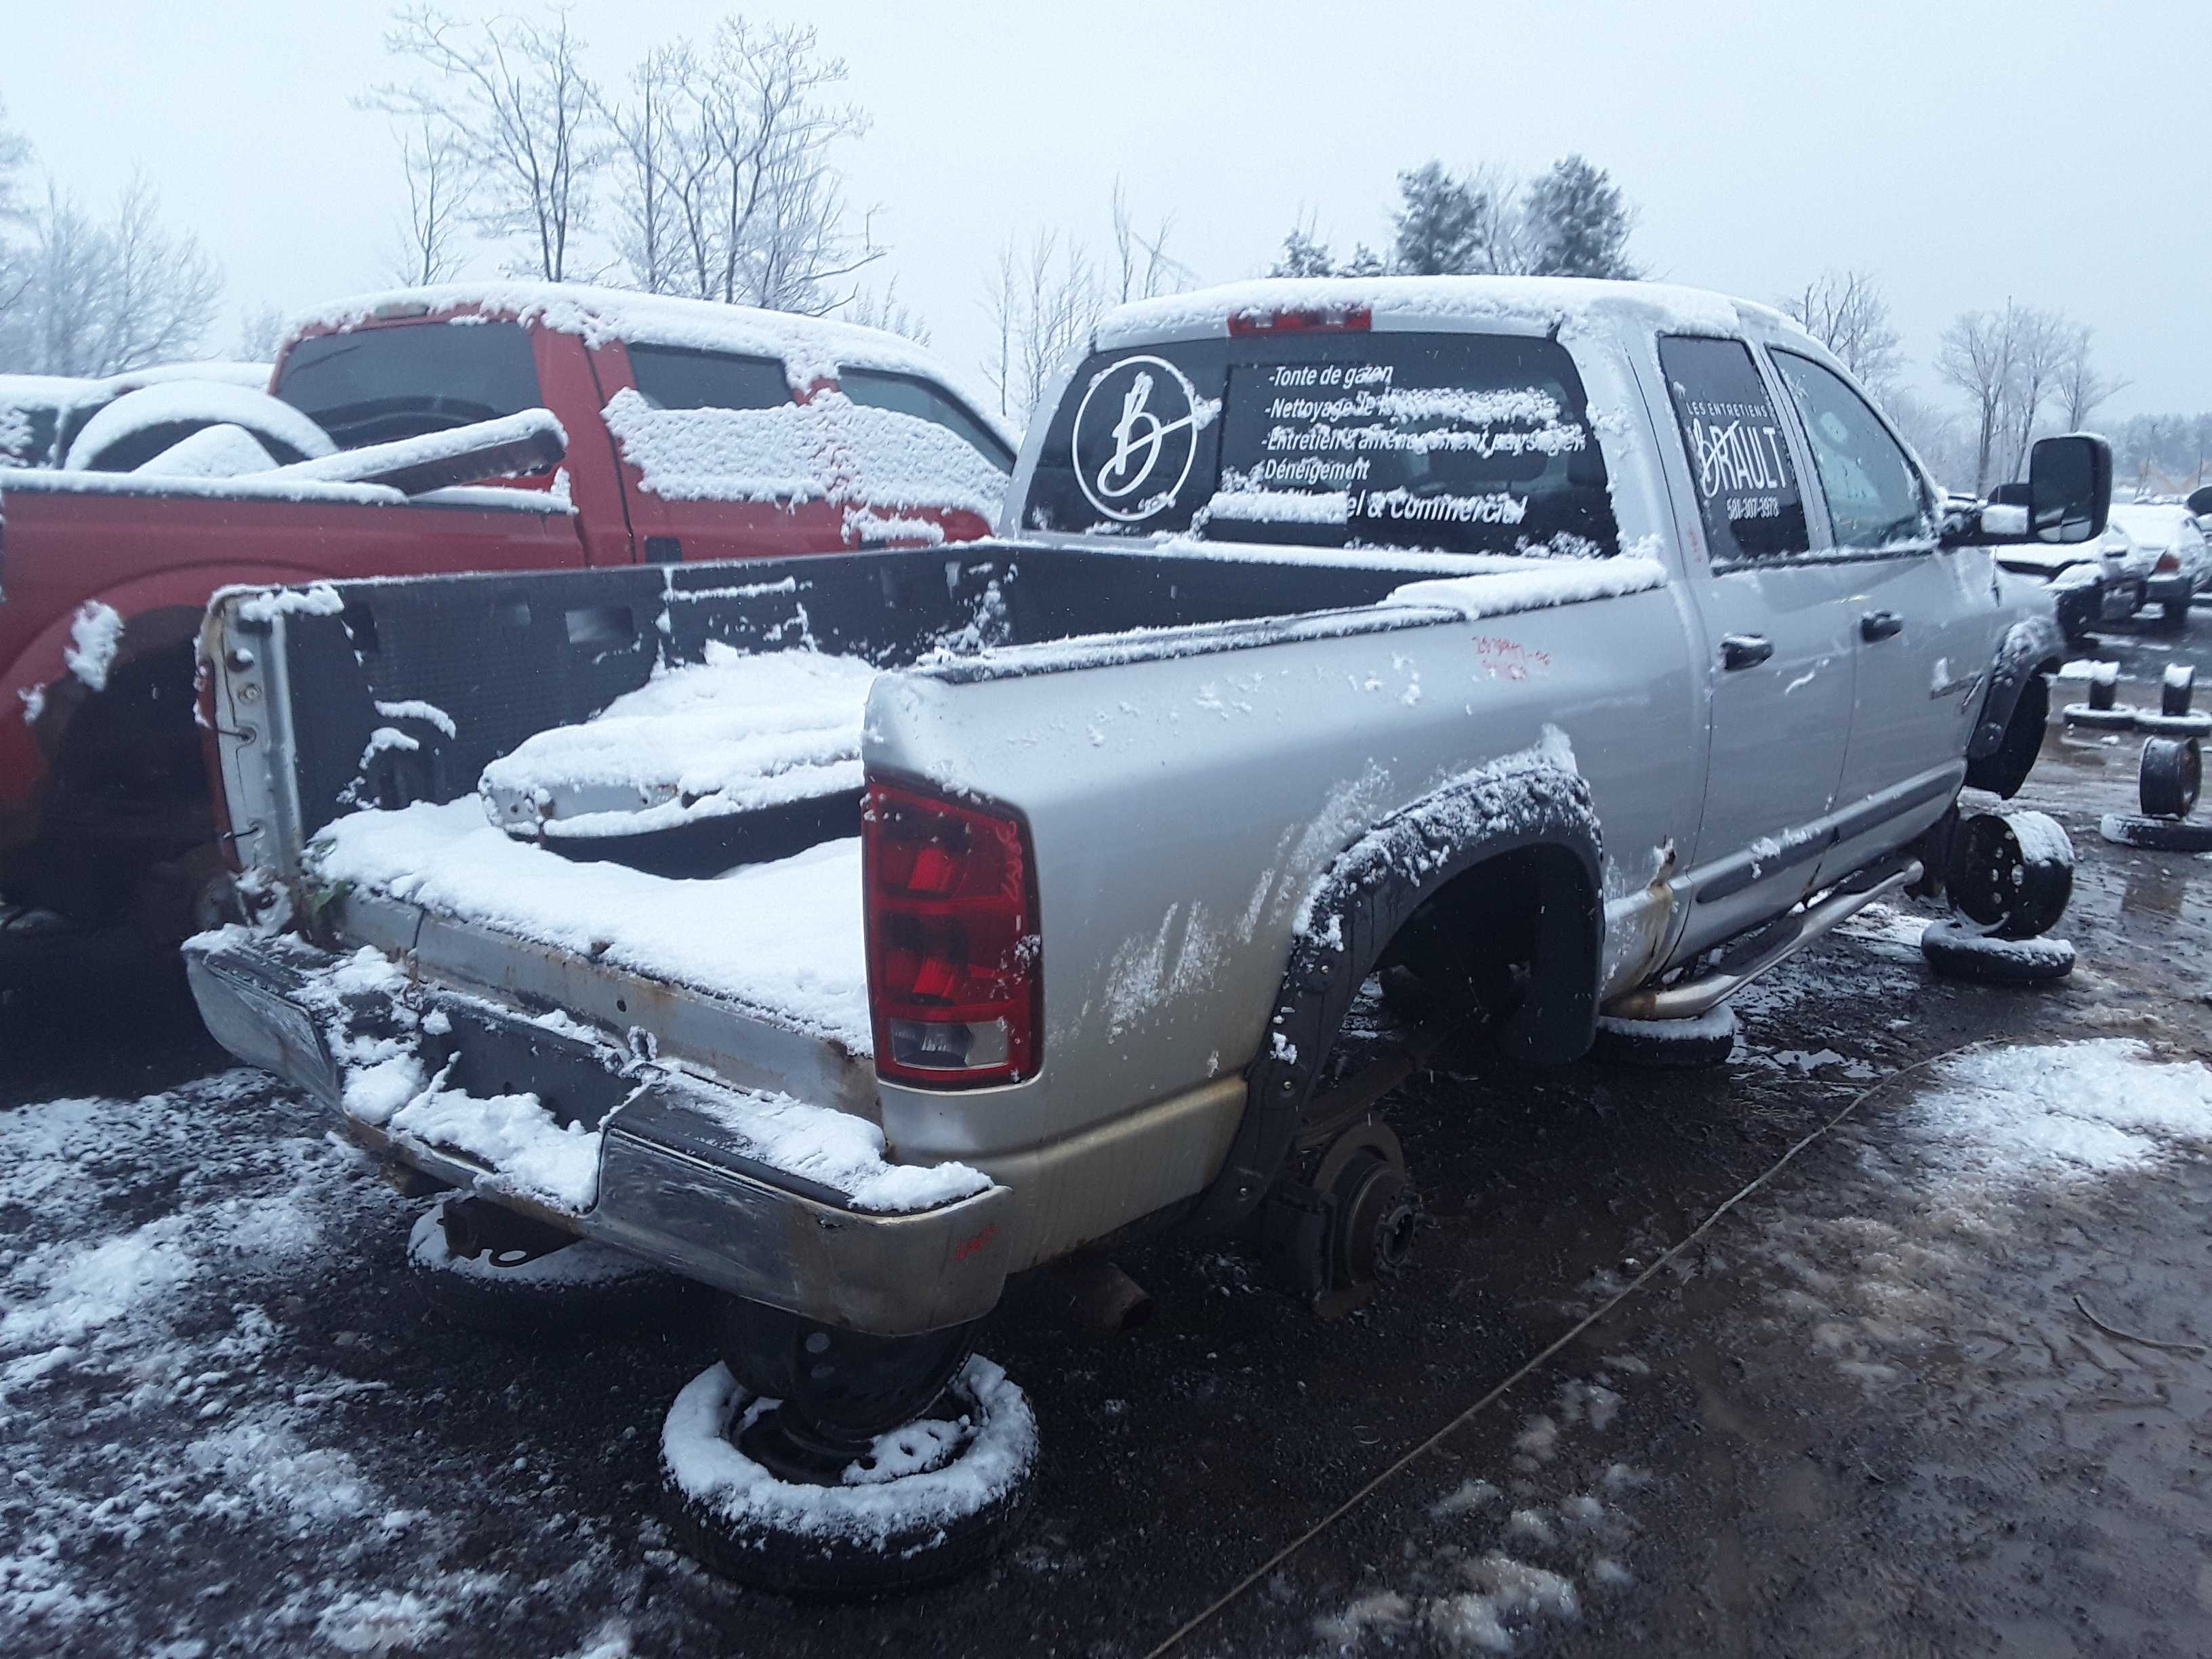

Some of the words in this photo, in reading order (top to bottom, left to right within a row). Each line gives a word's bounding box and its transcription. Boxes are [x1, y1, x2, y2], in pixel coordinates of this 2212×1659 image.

[1269, 366, 1316, 386] -Tonte
[1319, 364, 1342, 386] de
[1265, 397, 1355, 423] -Nettoyage
[1686, 401, 1706, 415] LES
[1707, 403, 1767, 417] ENTRETIENS
